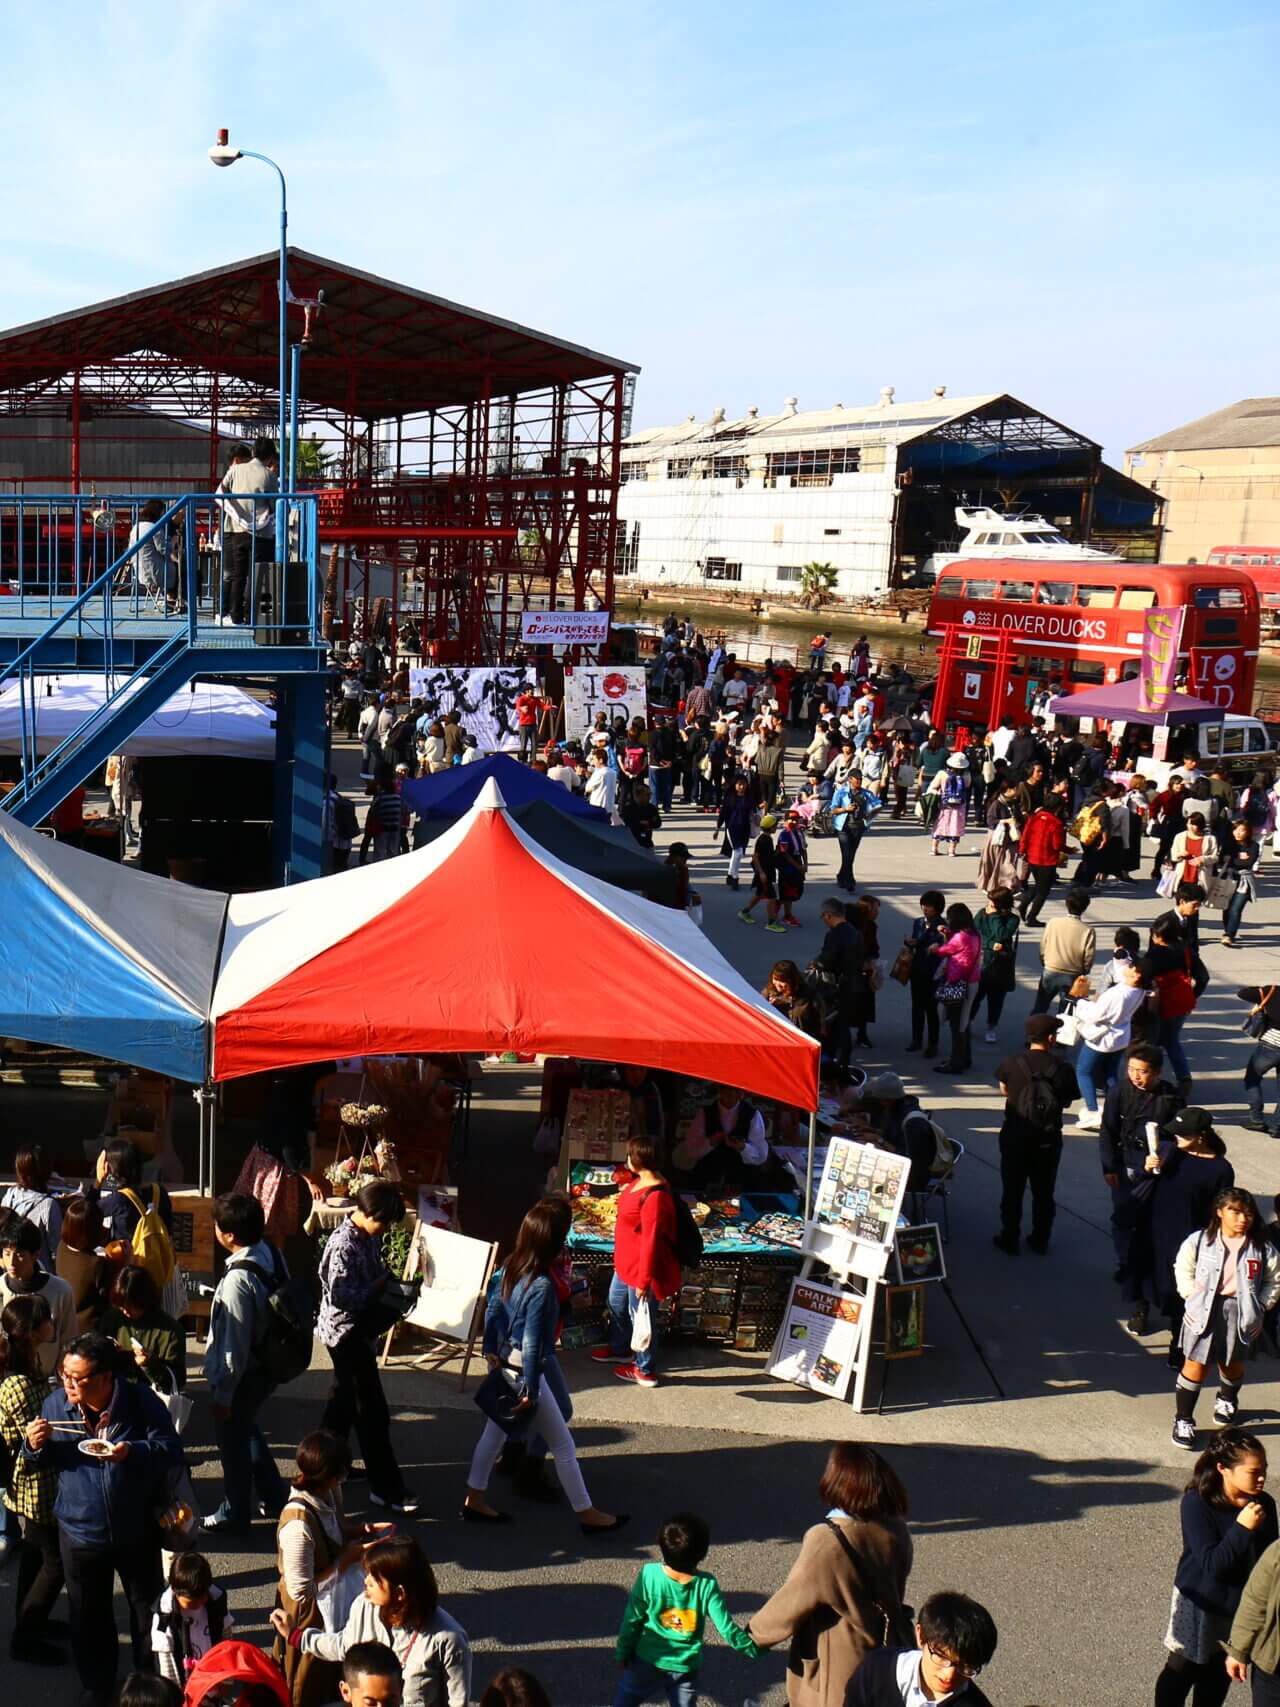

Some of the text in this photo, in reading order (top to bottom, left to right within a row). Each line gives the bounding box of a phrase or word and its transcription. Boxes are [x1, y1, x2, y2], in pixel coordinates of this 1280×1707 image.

[574, 615, 597, 623] DUCKS
[993, 613, 1107, 640] LOVER DUCKS
[1197, 655, 1213, 682] I
[797, 1288, 834, 1306] CHALK
[809, 1300, 833, 1313] ART
